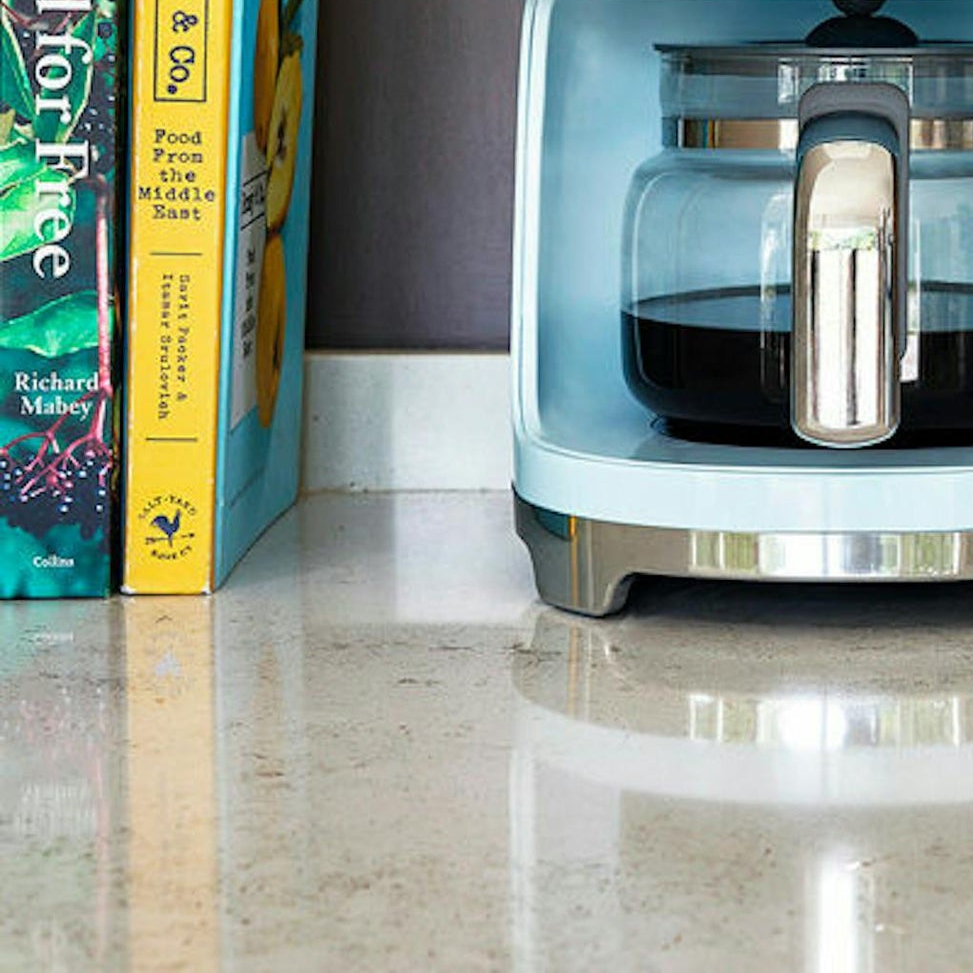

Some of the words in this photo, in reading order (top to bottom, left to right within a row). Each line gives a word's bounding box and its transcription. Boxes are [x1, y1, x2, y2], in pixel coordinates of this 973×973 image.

[171, 11, 199, 34] &
[35, 30, 93, 123] for
[167, 45, 195, 95] Co.
[154, 128, 202, 145] Food
[153, 148, 203, 163] From
[159, 167, 196, 182] the
[138, 187, 215, 202] Middle
[33, 138, 91, 279] Free
[153, 204, 201, 221] East
[14, 371, 99, 392] Richard
[20, 395, 93, 422] Mabey
[32, 555, 75, 569] Collins
